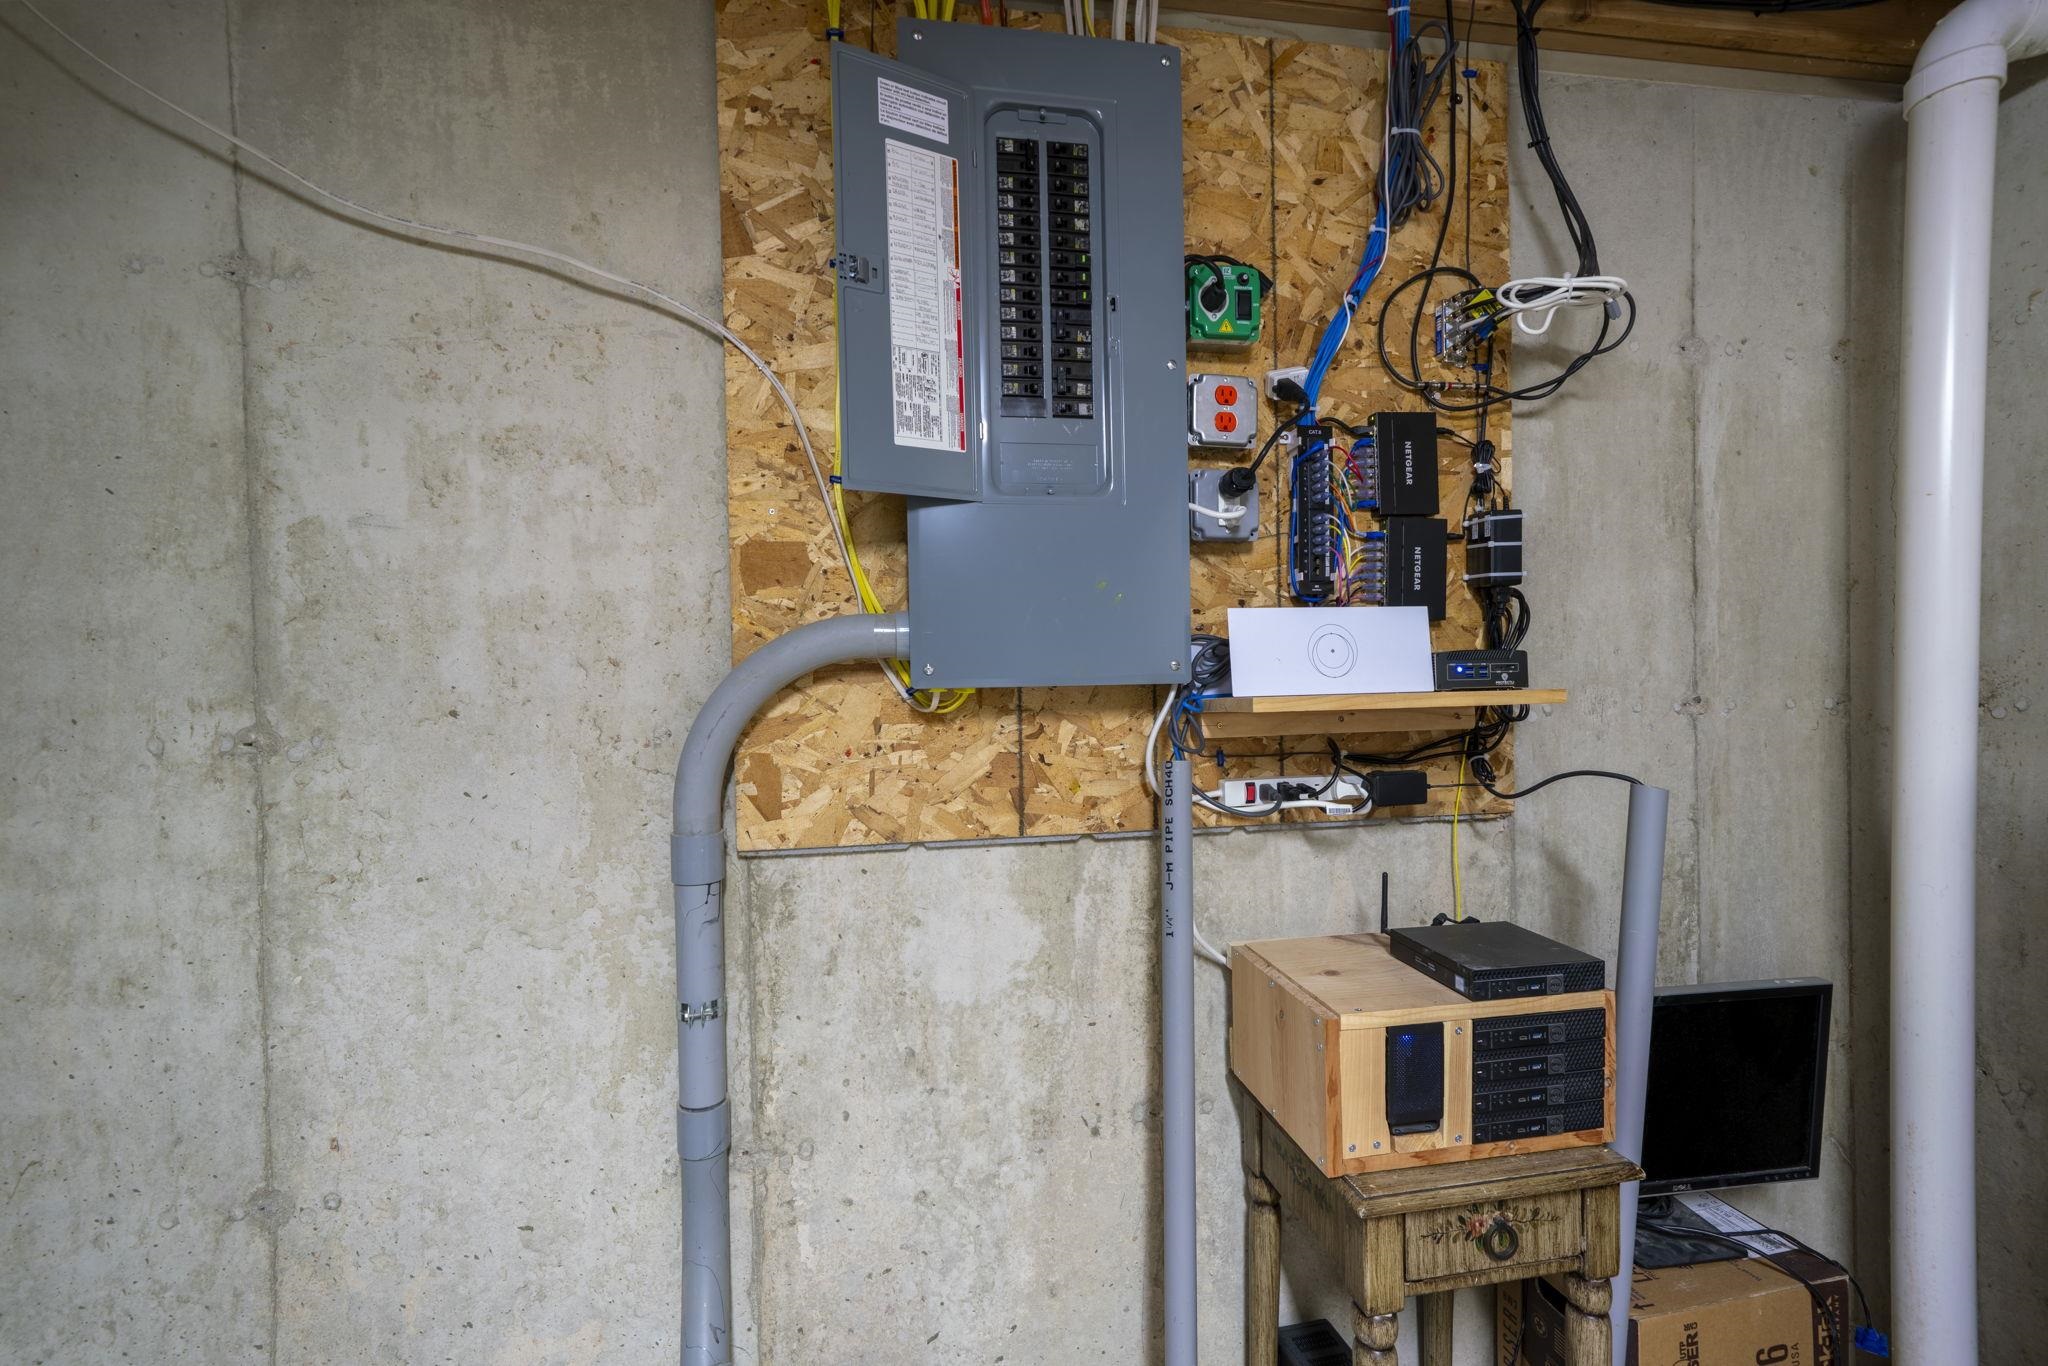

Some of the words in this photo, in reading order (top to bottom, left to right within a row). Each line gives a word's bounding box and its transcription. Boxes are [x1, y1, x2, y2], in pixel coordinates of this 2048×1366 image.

[1405, 441, 1413, 486] NETGEAR
[1165, 817, 1174, 853] PIPE
[1165, 862, 1174, 891] J-M
[1756, 1343, 1788, 1366] 6
